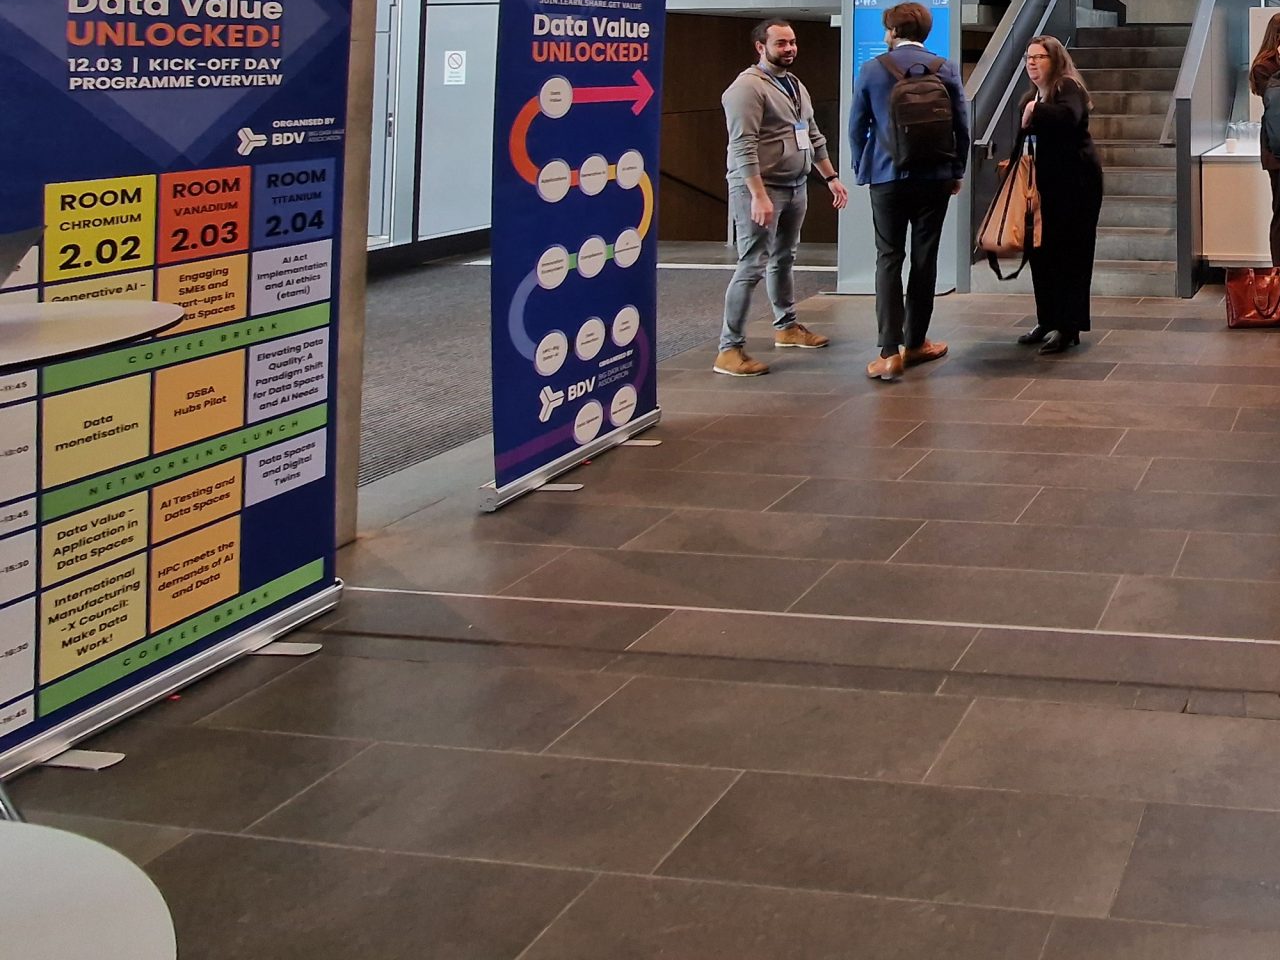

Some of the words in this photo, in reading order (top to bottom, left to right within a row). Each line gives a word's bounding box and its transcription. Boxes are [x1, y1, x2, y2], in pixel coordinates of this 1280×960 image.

[622, 1, 643, 10] VALUE
[66, 20, 281, 48] UNLOCKED!
[533, 14, 588, 37] Data
[591, 16, 650, 38] Value
[532, 41, 649, 63] UNLOCKED!
[68, 57, 122, 72] 12.03
[149, 57, 241, 71] KICK-OFF
[244, 57, 282, 71] DAY
[69, 74, 194, 90] PROGRAMME
[197, 74, 283, 87] OVERVIEW
[272, 119, 323, 128] ORGANISED
[272, 132, 305, 145] BDV
[172, 177, 241, 199] ROOM
[266, 168, 327, 189] ROOM
[60, 187, 142, 211] ROOM
[173, 201, 239, 217] VANADIUM
[271, 192, 322, 205] TITANIUM
[59, 213, 142, 232] CHROMIUM
[265, 210, 324, 238] 2.04
[170, 221, 239, 253] 2.03
[58, 235, 141, 271] 2.02
[282, 256, 291, 264] AI
[293, 253, 308, 262] Act
[179, 267, 229, 283] Engaging
[265, 280, 283, 291] and
[285, 278, 295, 286] AI
[296, 274, 321, 285] ethics
[125, 283, 138, 292] AI
[178, 285, 206, 296] SMEs
[207, 279, 229, 290] and
[225, 291, 235, 300] in
[198, 304, 236, 320] Spaces
[128, 339, 205, 364] COFFEE
[221, 322, 279, 342] BREAK
[257, 341, 301, 362] Elevating
[303, 338, 324, 350] Data
[307, 352, 313, 360] A
[255, 367, 302, 387] Paradigm
[304, 361, 324, 373] Shift
[187, 386, 215, 400] DSBA
[252, 390, 268, 401] for
[268, 383, 292, 396] Data
[293, 373, 325, 388] Spaces
[259, 399, 279, 411] and
[280, 395, 290, 404] AI
[291, 386, 319, 401] Needs
[567, 376, 596, 401] BDV
[174, 403, 201, 417] Hubs
[203, 395, 228, 408] Pilot
[83, 415, 114, 430] Data
[55, 422, 139, 452] monetisation
[89, 444, 228, 496] NETWORKING
[242, 420, 299, 445] LUNCH
[258, 454, 282, 468] Data
[283, 442, 317, 458] Spaces
[262, 466, 282, 479] and
[283, 454, 313, 471] Digital
[274, 472, 301, 486] Twins
[160, 499, 171, 510] AI
[173, 485, 213, 503] Testing
[215, 476, 236, 489] and
[164, 507, 191, 522] Data
[193, 492, 231, 512] Spaces
[57, 523, 88, 541] Data
[91, 510, 126, 528] Value
[52, 524, 126, 557] Application
[127, 520, 139, 530] in
[57, 552, 88, 571] Data
[90, 535, 134, 558] Spaces
[157, 562, 181, 579] HPC
[182, 547, 216, 569] meets
[217, 541, 235, 553] the
[157, 564, 210, 592] demands
[211, 559, 223, 569] of
[223, 553, 235, 563] AI
[54, 568, 136, 608] International
[171, 585, 194, 600] and
[195, 572, 221, 589] Data
[47, 580, 141, 625] Manufacturing
[61, 628, 97, 649] Make
[98, 614, 128, 632] Data
[123, 624, 199, 667] COFFEE
[214, 591, 269, 623] BREAK
[76, 633, 113, 657] Work!
